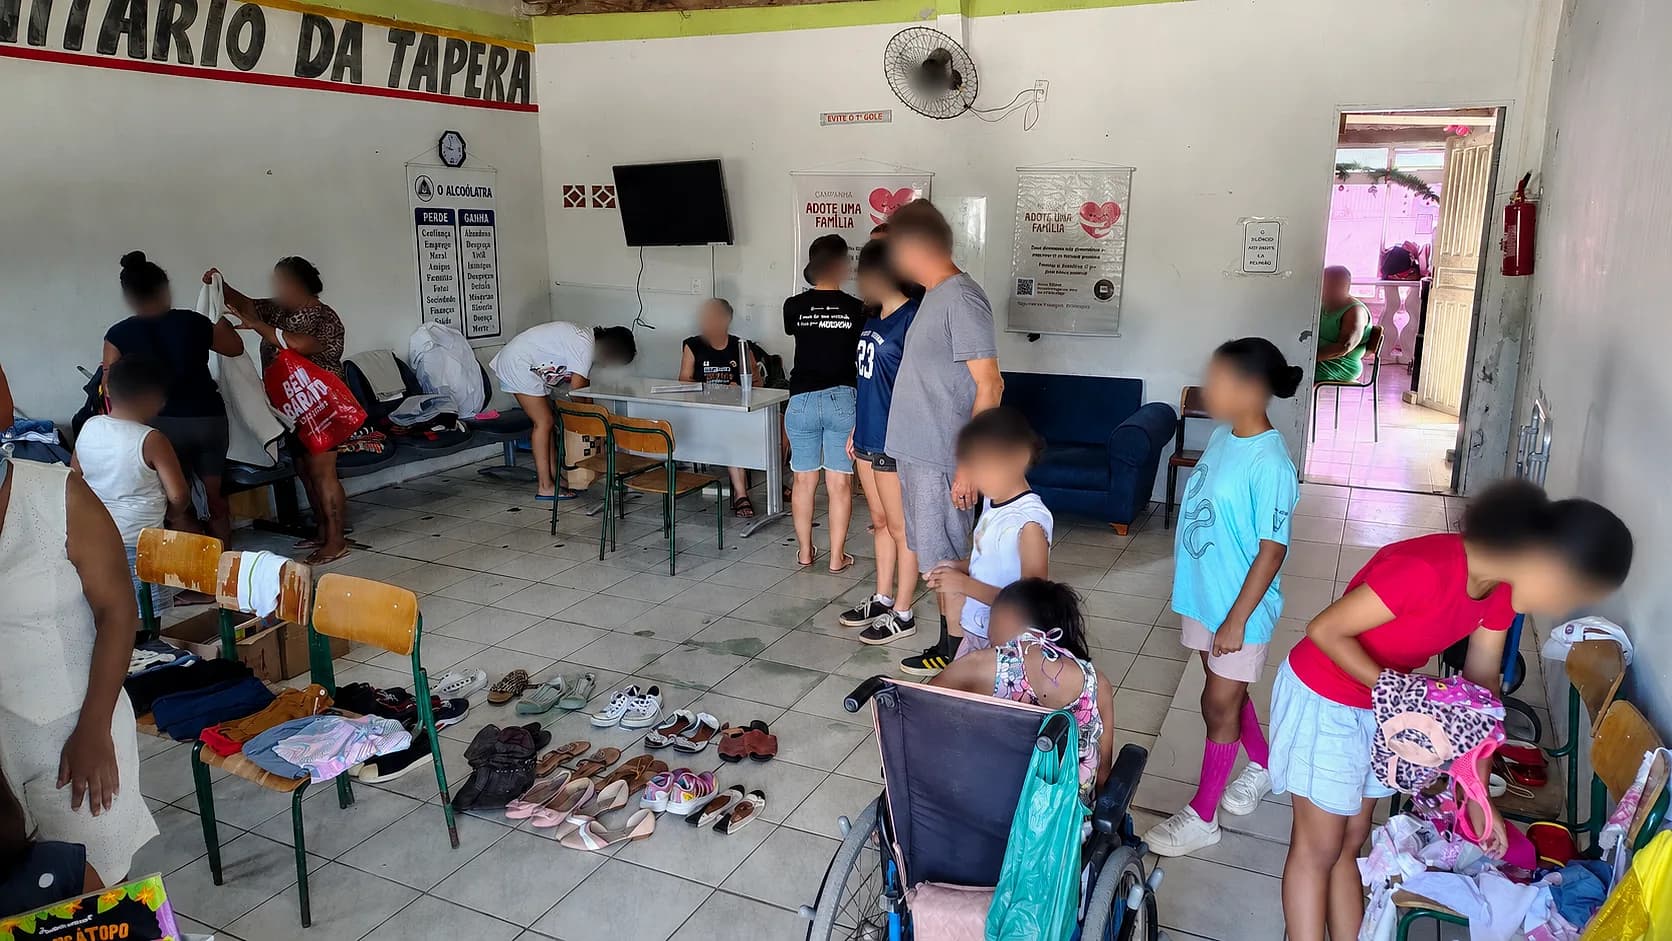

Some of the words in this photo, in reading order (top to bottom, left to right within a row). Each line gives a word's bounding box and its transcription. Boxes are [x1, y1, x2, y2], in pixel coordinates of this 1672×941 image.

[295, 12, 363, 84] DA
[388, 28, 531, 105] TAPERA
[827, 114, 847, 122] EVITE
[864, 112, 883, 121] GOLE
[437, 184, 444, 196] O
[446, 183, 493, 198] ALCOÓLATRA
[815, 191, 853, 199] CAMPANHA
[806, 203, 838, 214] ADOTE
[841, 203, 862, 214] UMA
[423, 212, 448, 223] PERDE
[464, 213, 489, 223] GANHA
[815, 214, 854, 228] FAMÍLIA
[1024, 212, 1052, 222] ADOTE
[1054, 213, 1072, 222] UMA
[857, 339, 875, 379] 23
[282, 366, 312, 400] BEM
